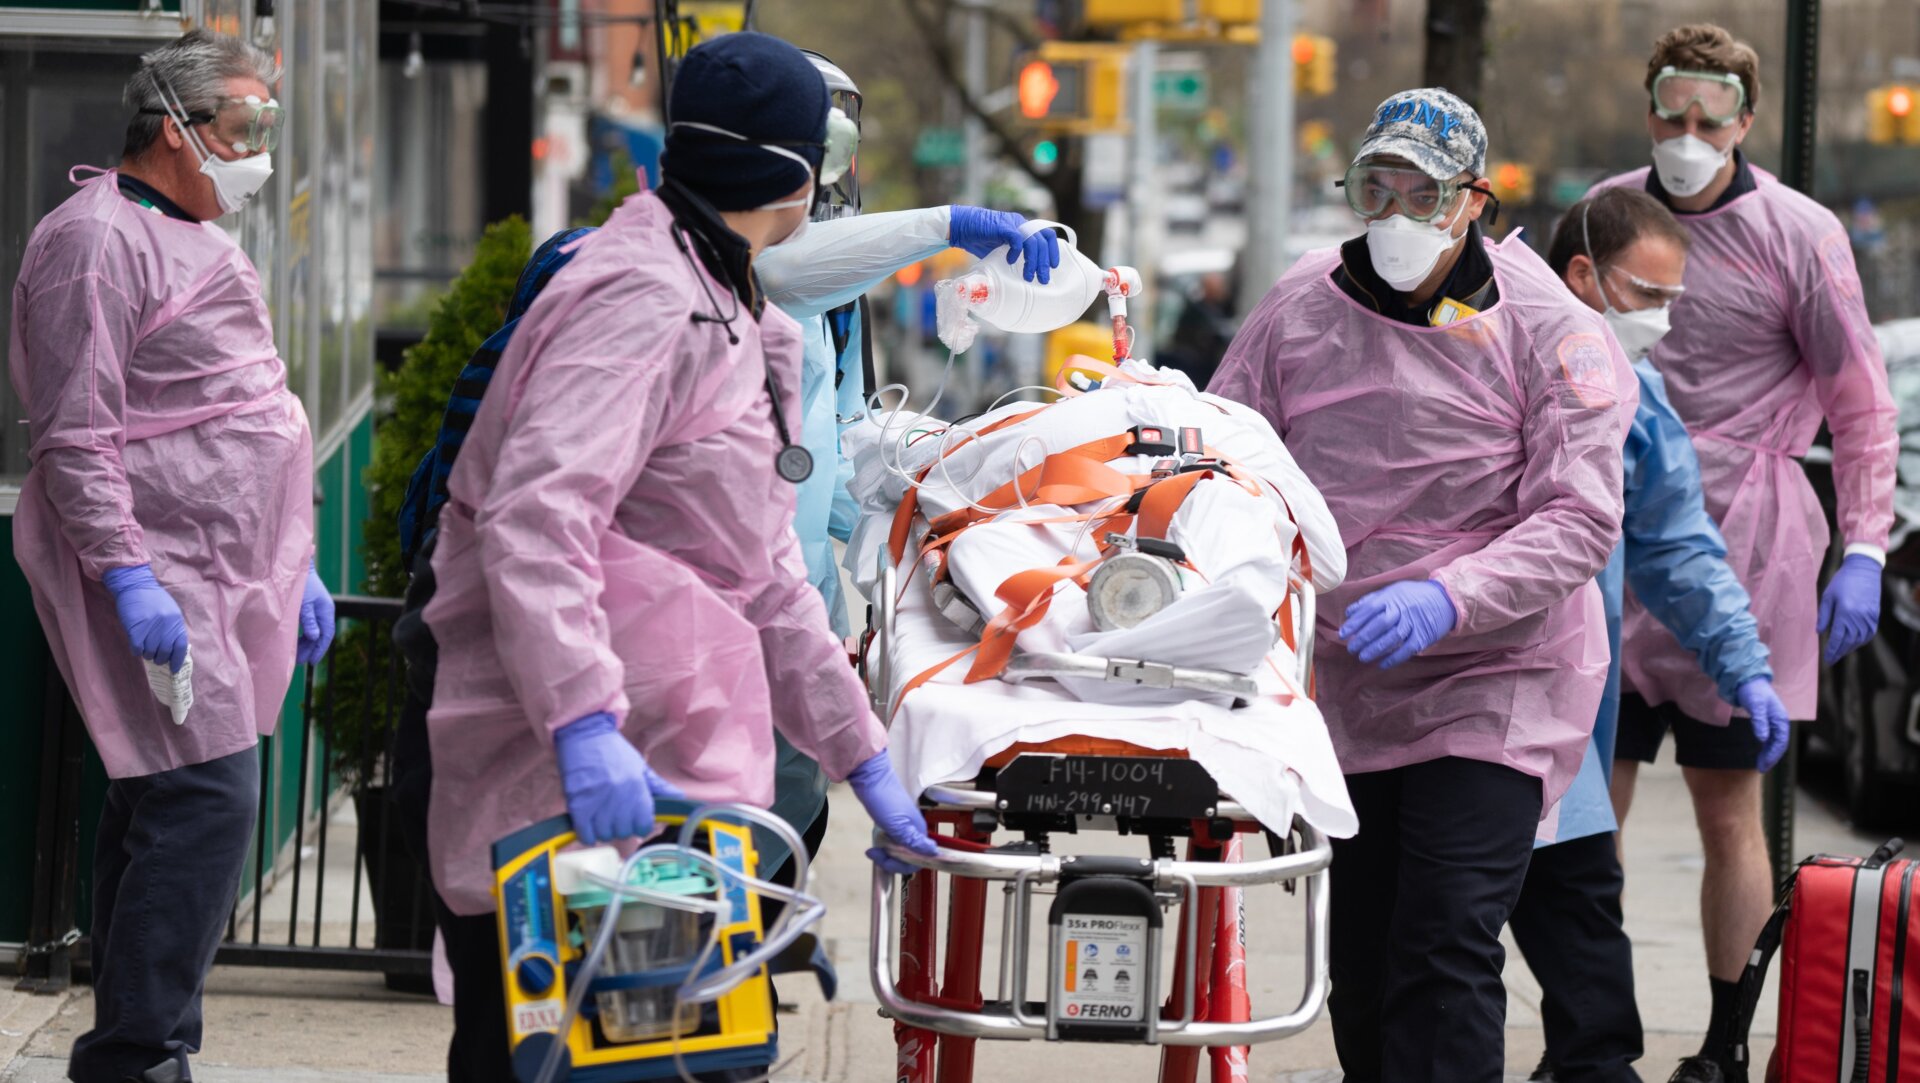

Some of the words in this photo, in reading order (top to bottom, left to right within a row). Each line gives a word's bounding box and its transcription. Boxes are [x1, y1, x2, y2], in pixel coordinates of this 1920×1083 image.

[1376, 99, 1461, 140] FDNY
[1050, 759, 1164, 784] F14-1004
[1067, 919, 1088, 929] 35x
[1080, 1004, 1132, 1018] FERNO
